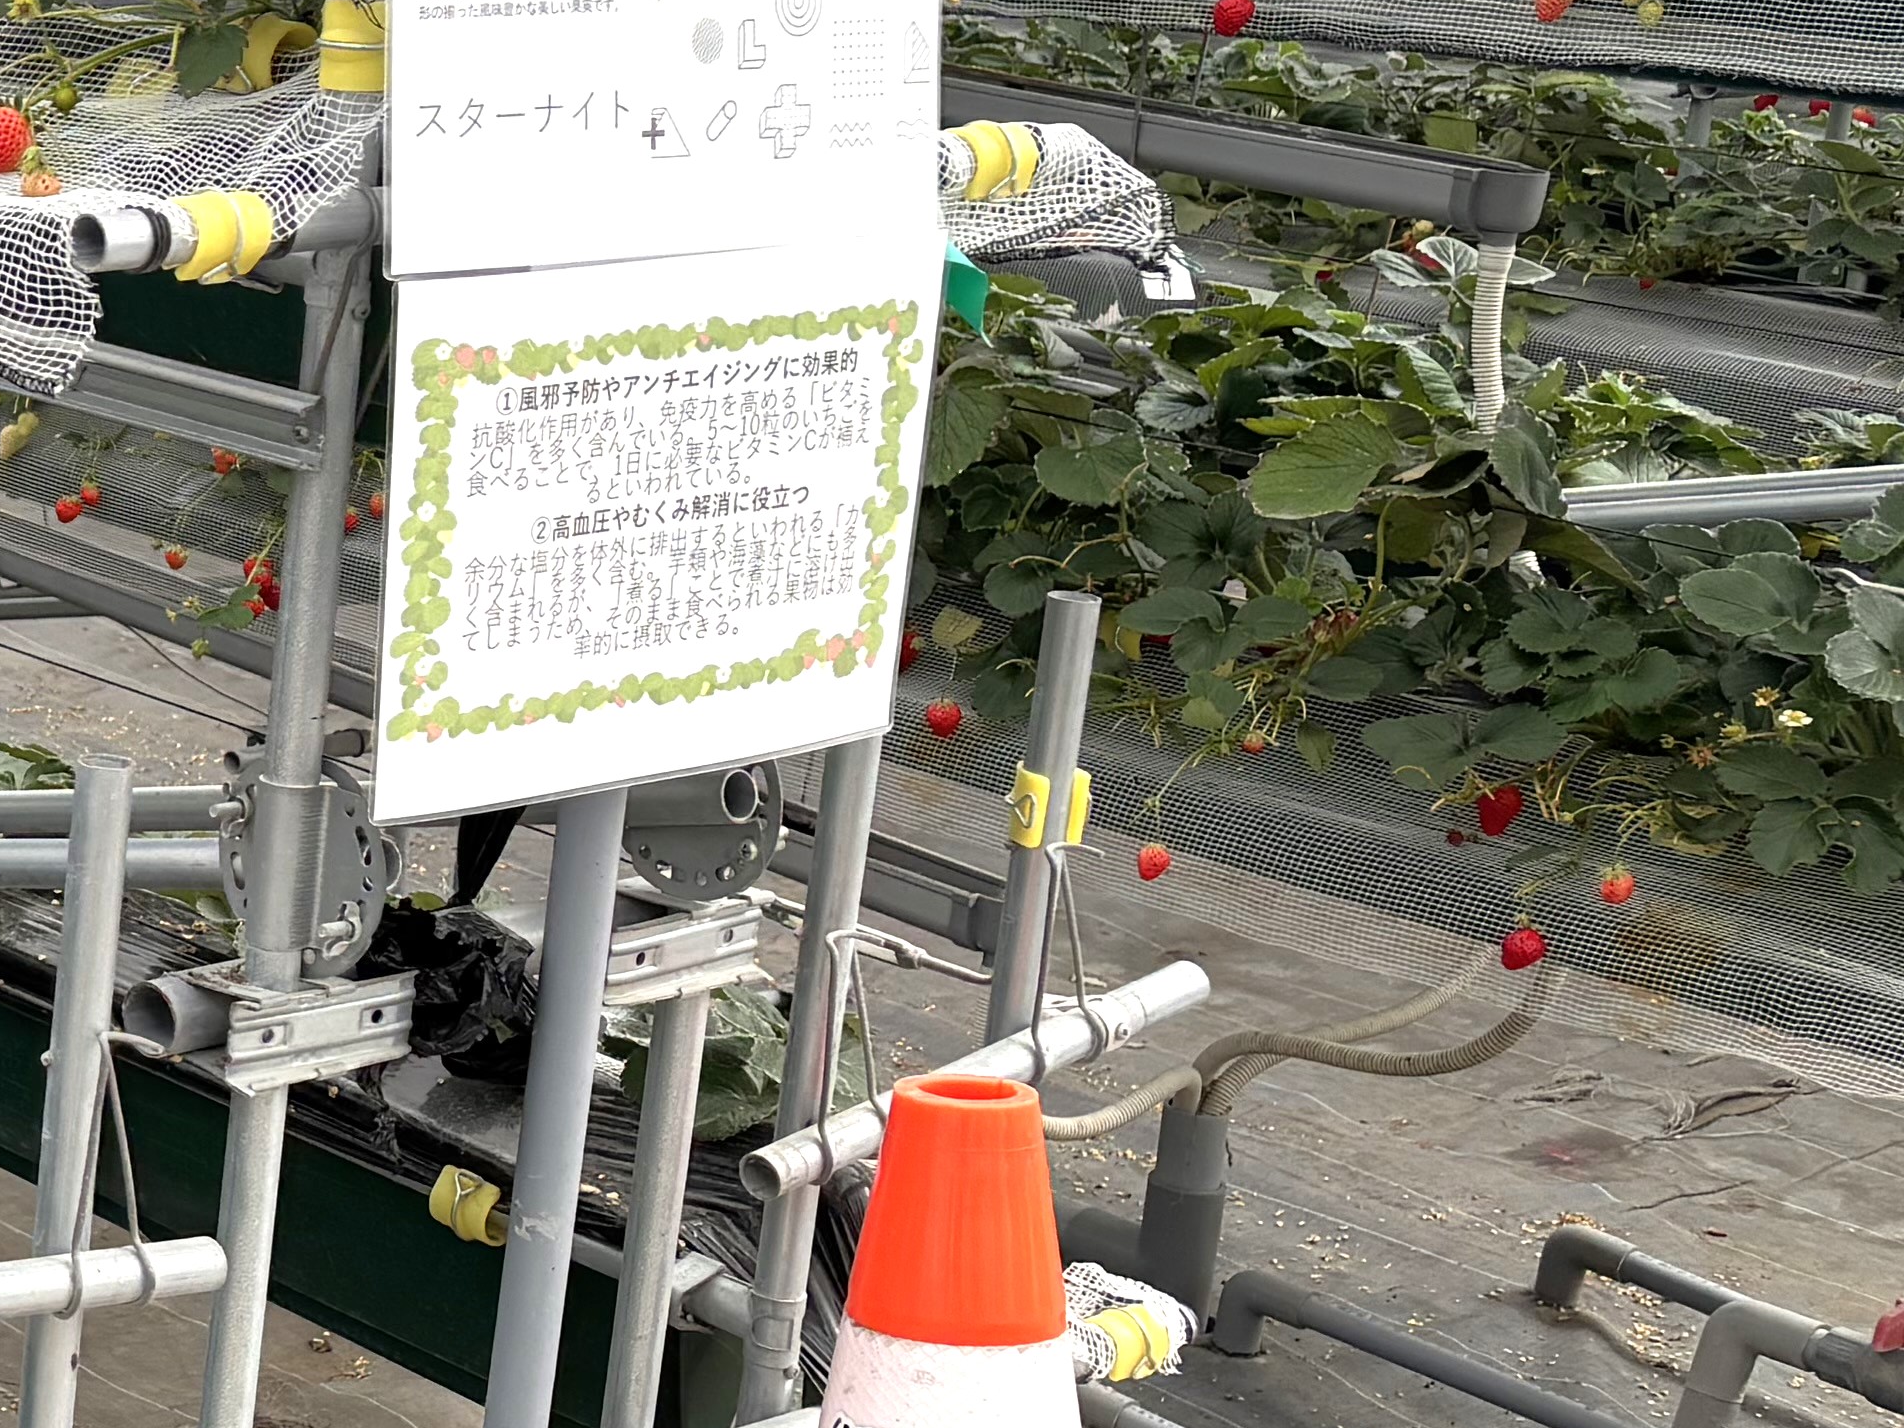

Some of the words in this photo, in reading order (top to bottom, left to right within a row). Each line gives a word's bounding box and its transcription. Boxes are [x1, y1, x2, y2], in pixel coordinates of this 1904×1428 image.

[416, 89, 631, 138] スターナイト
[495, 347, 859, 415] ①風邪予防やアンチエイジングに効果的
[586, 461, 751, 504] るといわれている。
[530, 483, 809, 544] ②高血圧やむくみ解消に役立つ
[573, 613, 740, 659] 率的に摂取できる。
